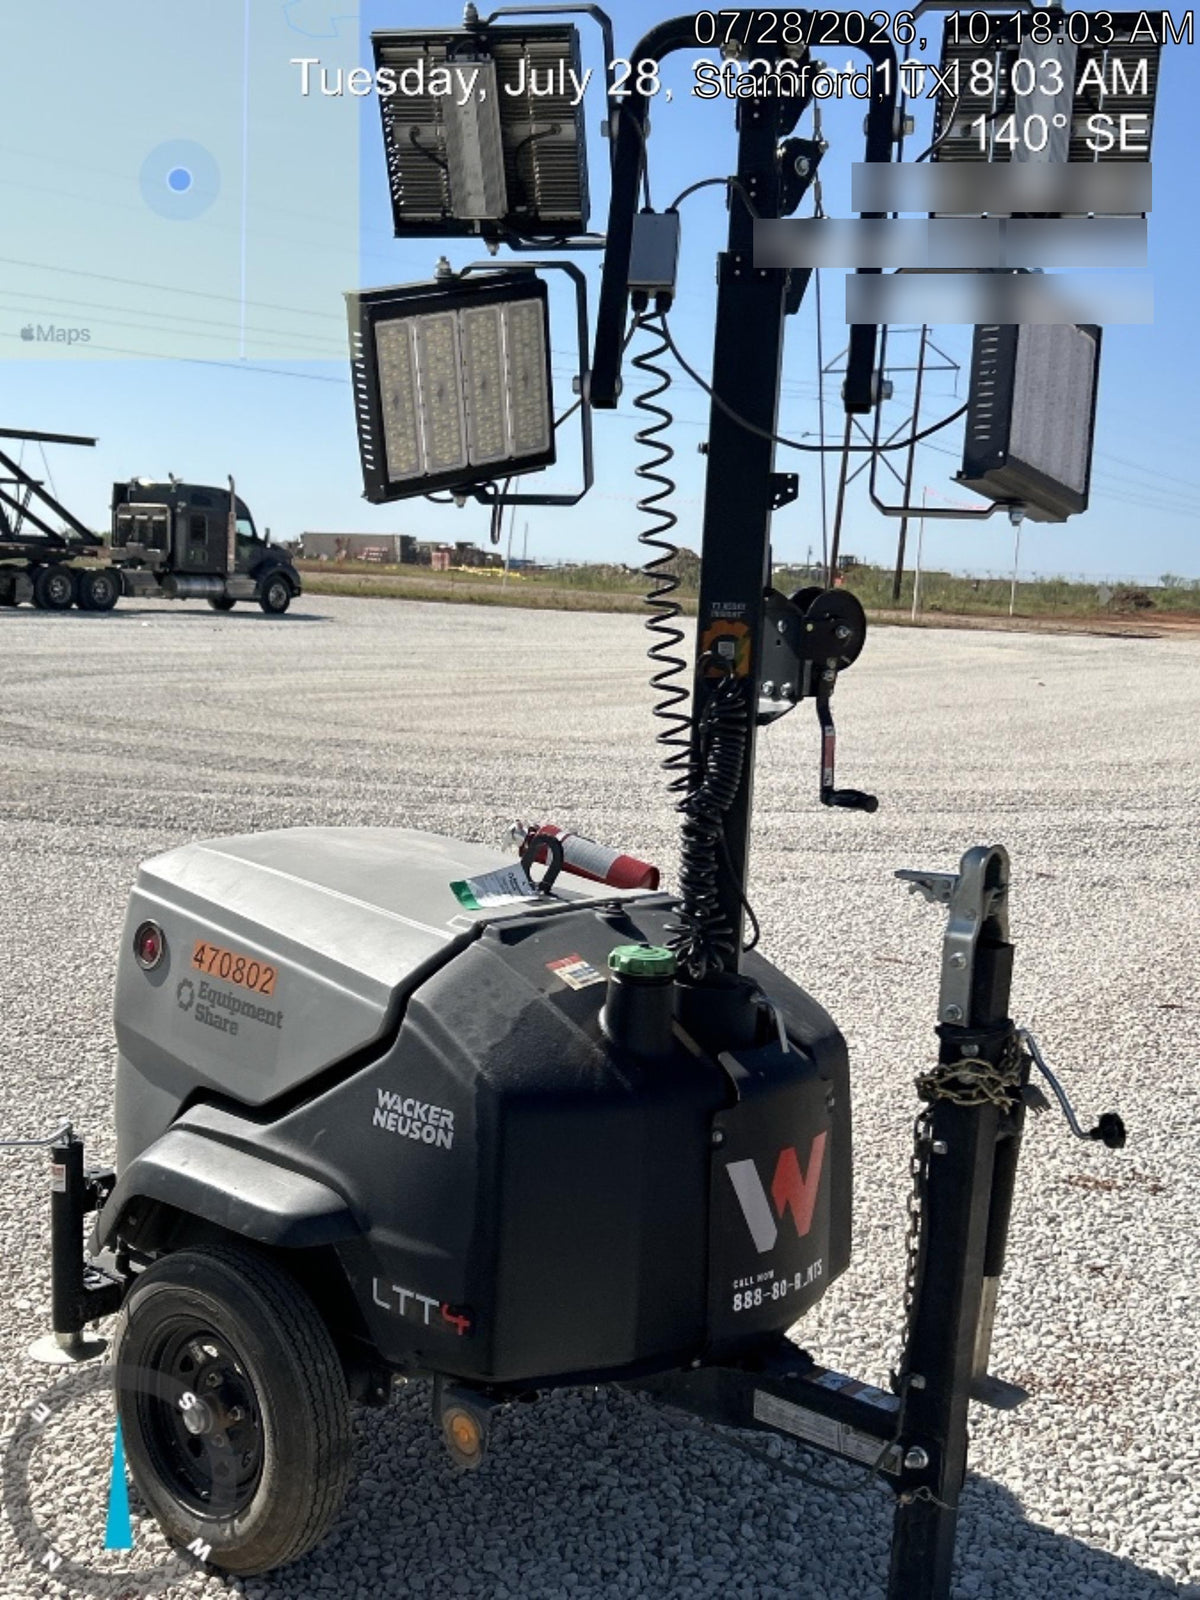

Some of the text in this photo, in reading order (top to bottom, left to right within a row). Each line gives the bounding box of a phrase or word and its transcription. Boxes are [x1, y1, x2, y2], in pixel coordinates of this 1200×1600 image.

[193, 944, 275, 995] 470802
[194, 1002, 239, 1036] Share
[197, 980, 283, 1030] Equipment
[372, 1107, 454, 1151] NEUSON
[376, 1088, 455, 1130] WACKER
[734, 1269, 774, 1290] CALL NOW
[373, 1277, 470, 1336] LTT4
